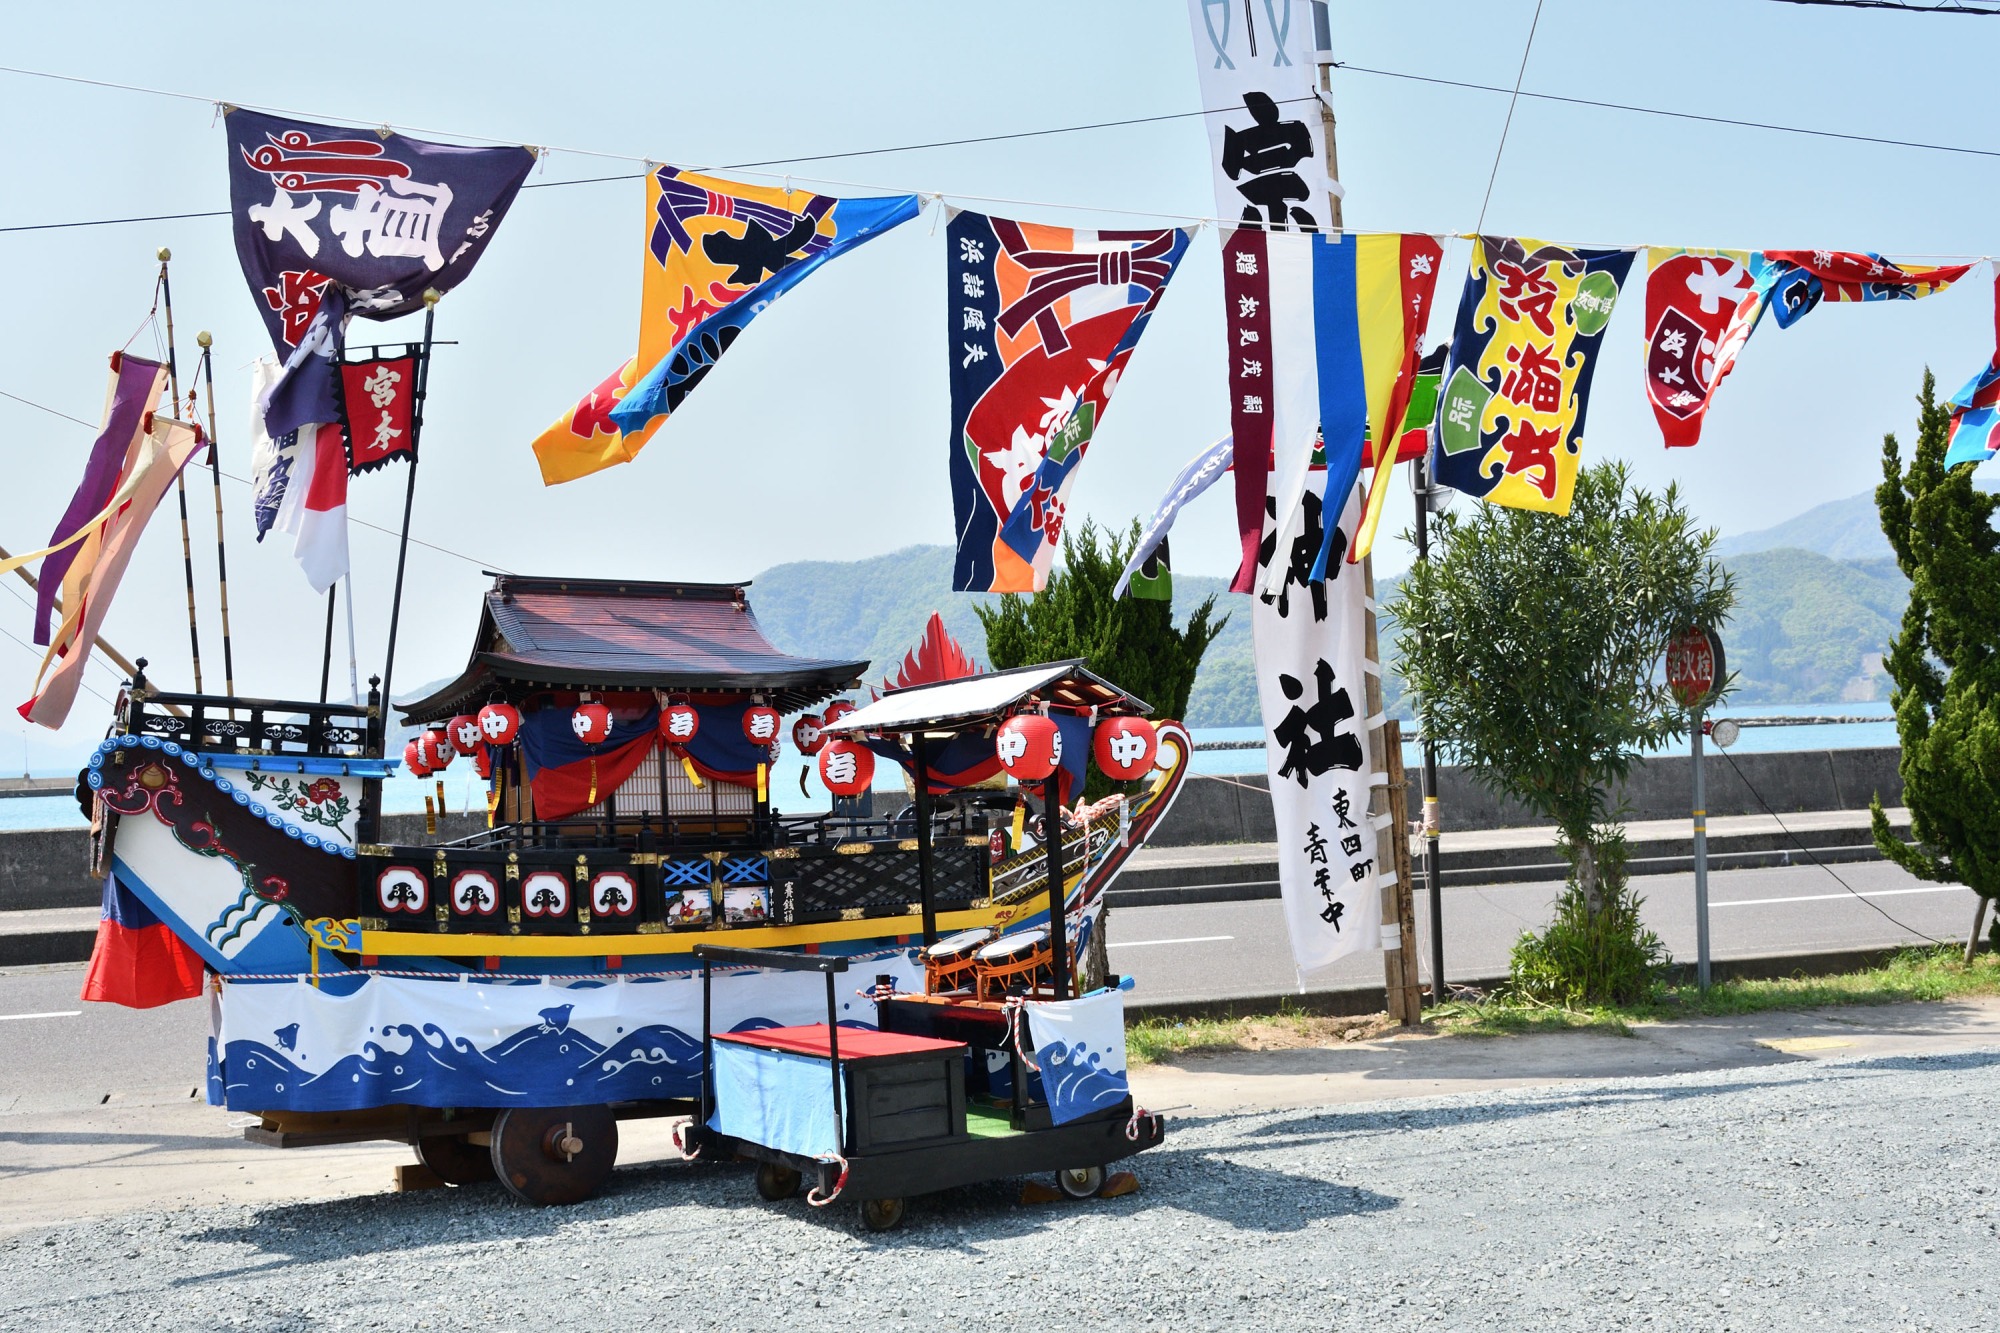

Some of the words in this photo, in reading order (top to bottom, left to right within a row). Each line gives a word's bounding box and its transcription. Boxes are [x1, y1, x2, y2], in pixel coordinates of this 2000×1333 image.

[1236, 251, 1258, 275] 贈
[1410, 254, 1434, 279] 祝
[960, 237, 988, 369] 浜詰隆夫
[1238, 294, 1263, 413] 松見茂嗣
[364, 366, 402, 450] 宮本
[1668, 650, 1711, 681] 消火栓
[458, 722, 482, 748] 中
[481, 711, 509, 739] 中
[572, 711, 592, 737] 中
[797, 723, 819, 748] 中
[997, 728, 1028, 767] 中
[1109, 730, 1147, 768] 中
[1332, 788, 1373, 882] 東四町
[1304, 822, 1345, 933] 青年中
